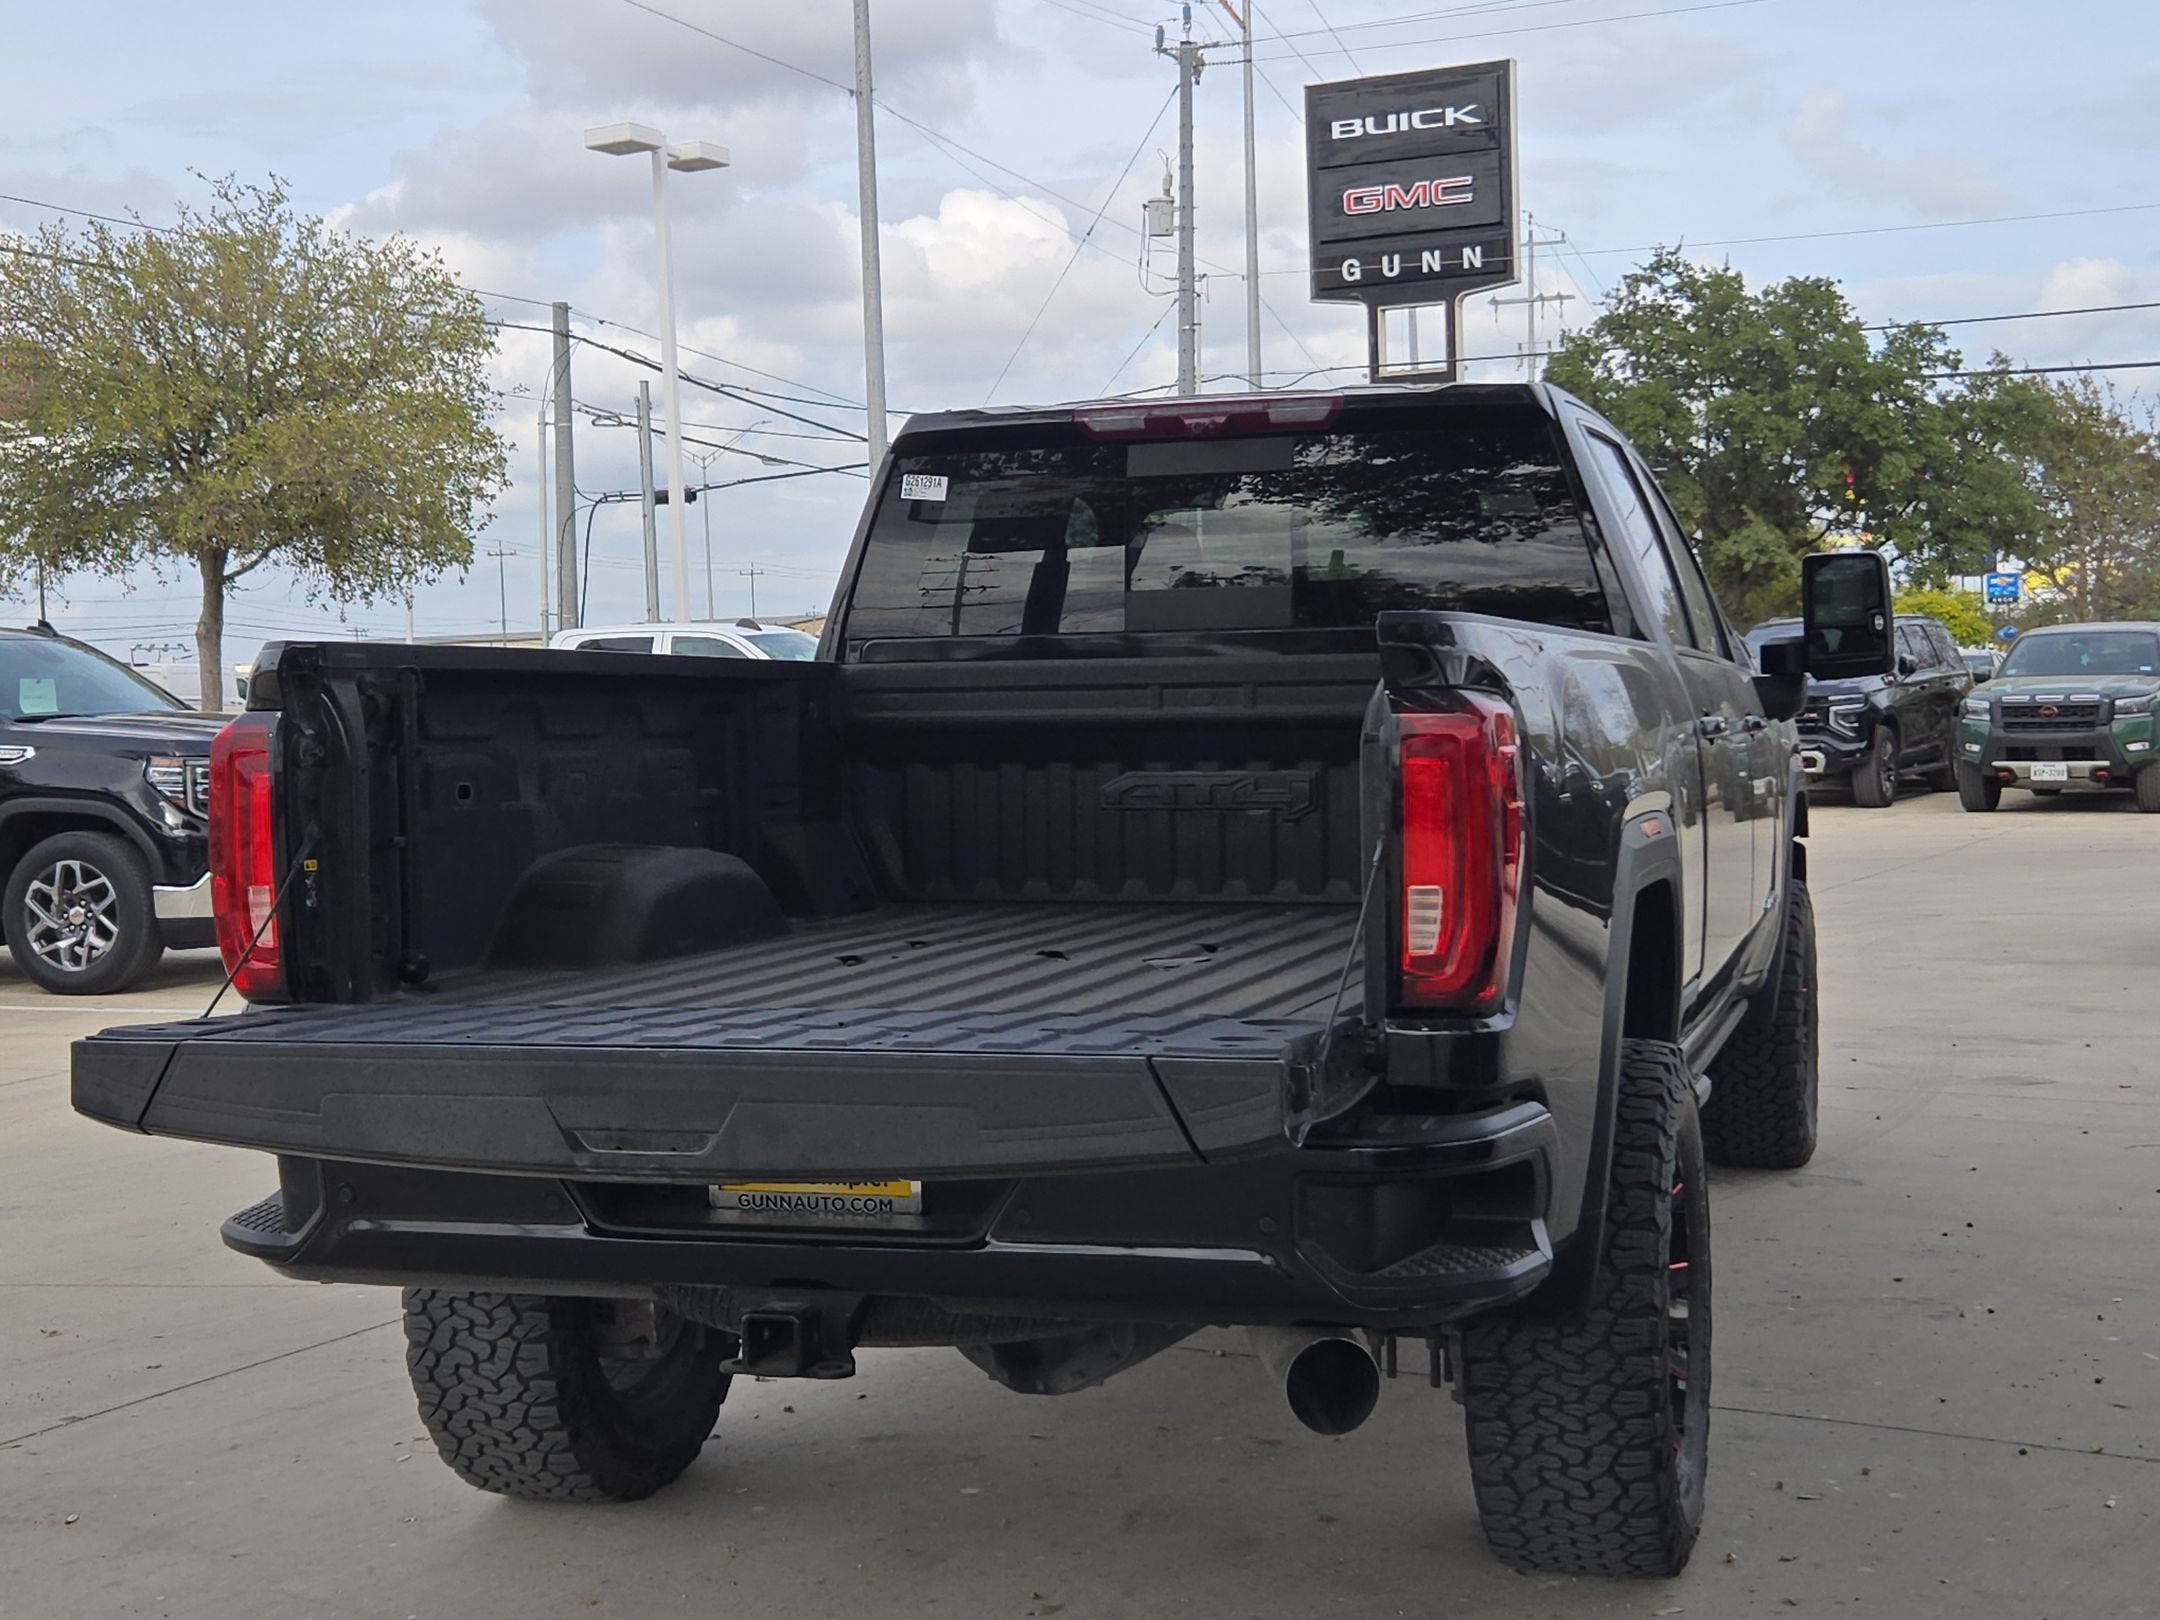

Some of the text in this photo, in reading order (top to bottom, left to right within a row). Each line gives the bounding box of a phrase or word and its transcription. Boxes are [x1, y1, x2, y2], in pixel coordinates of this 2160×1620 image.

[1331, 104, 1482, 140] BUICK
[1343, 175, 1474, 216] GMC
[1341, 245, 1483, 282] GUNN
[738, 1193, 894, 1213] GUNNAUTO.COM
